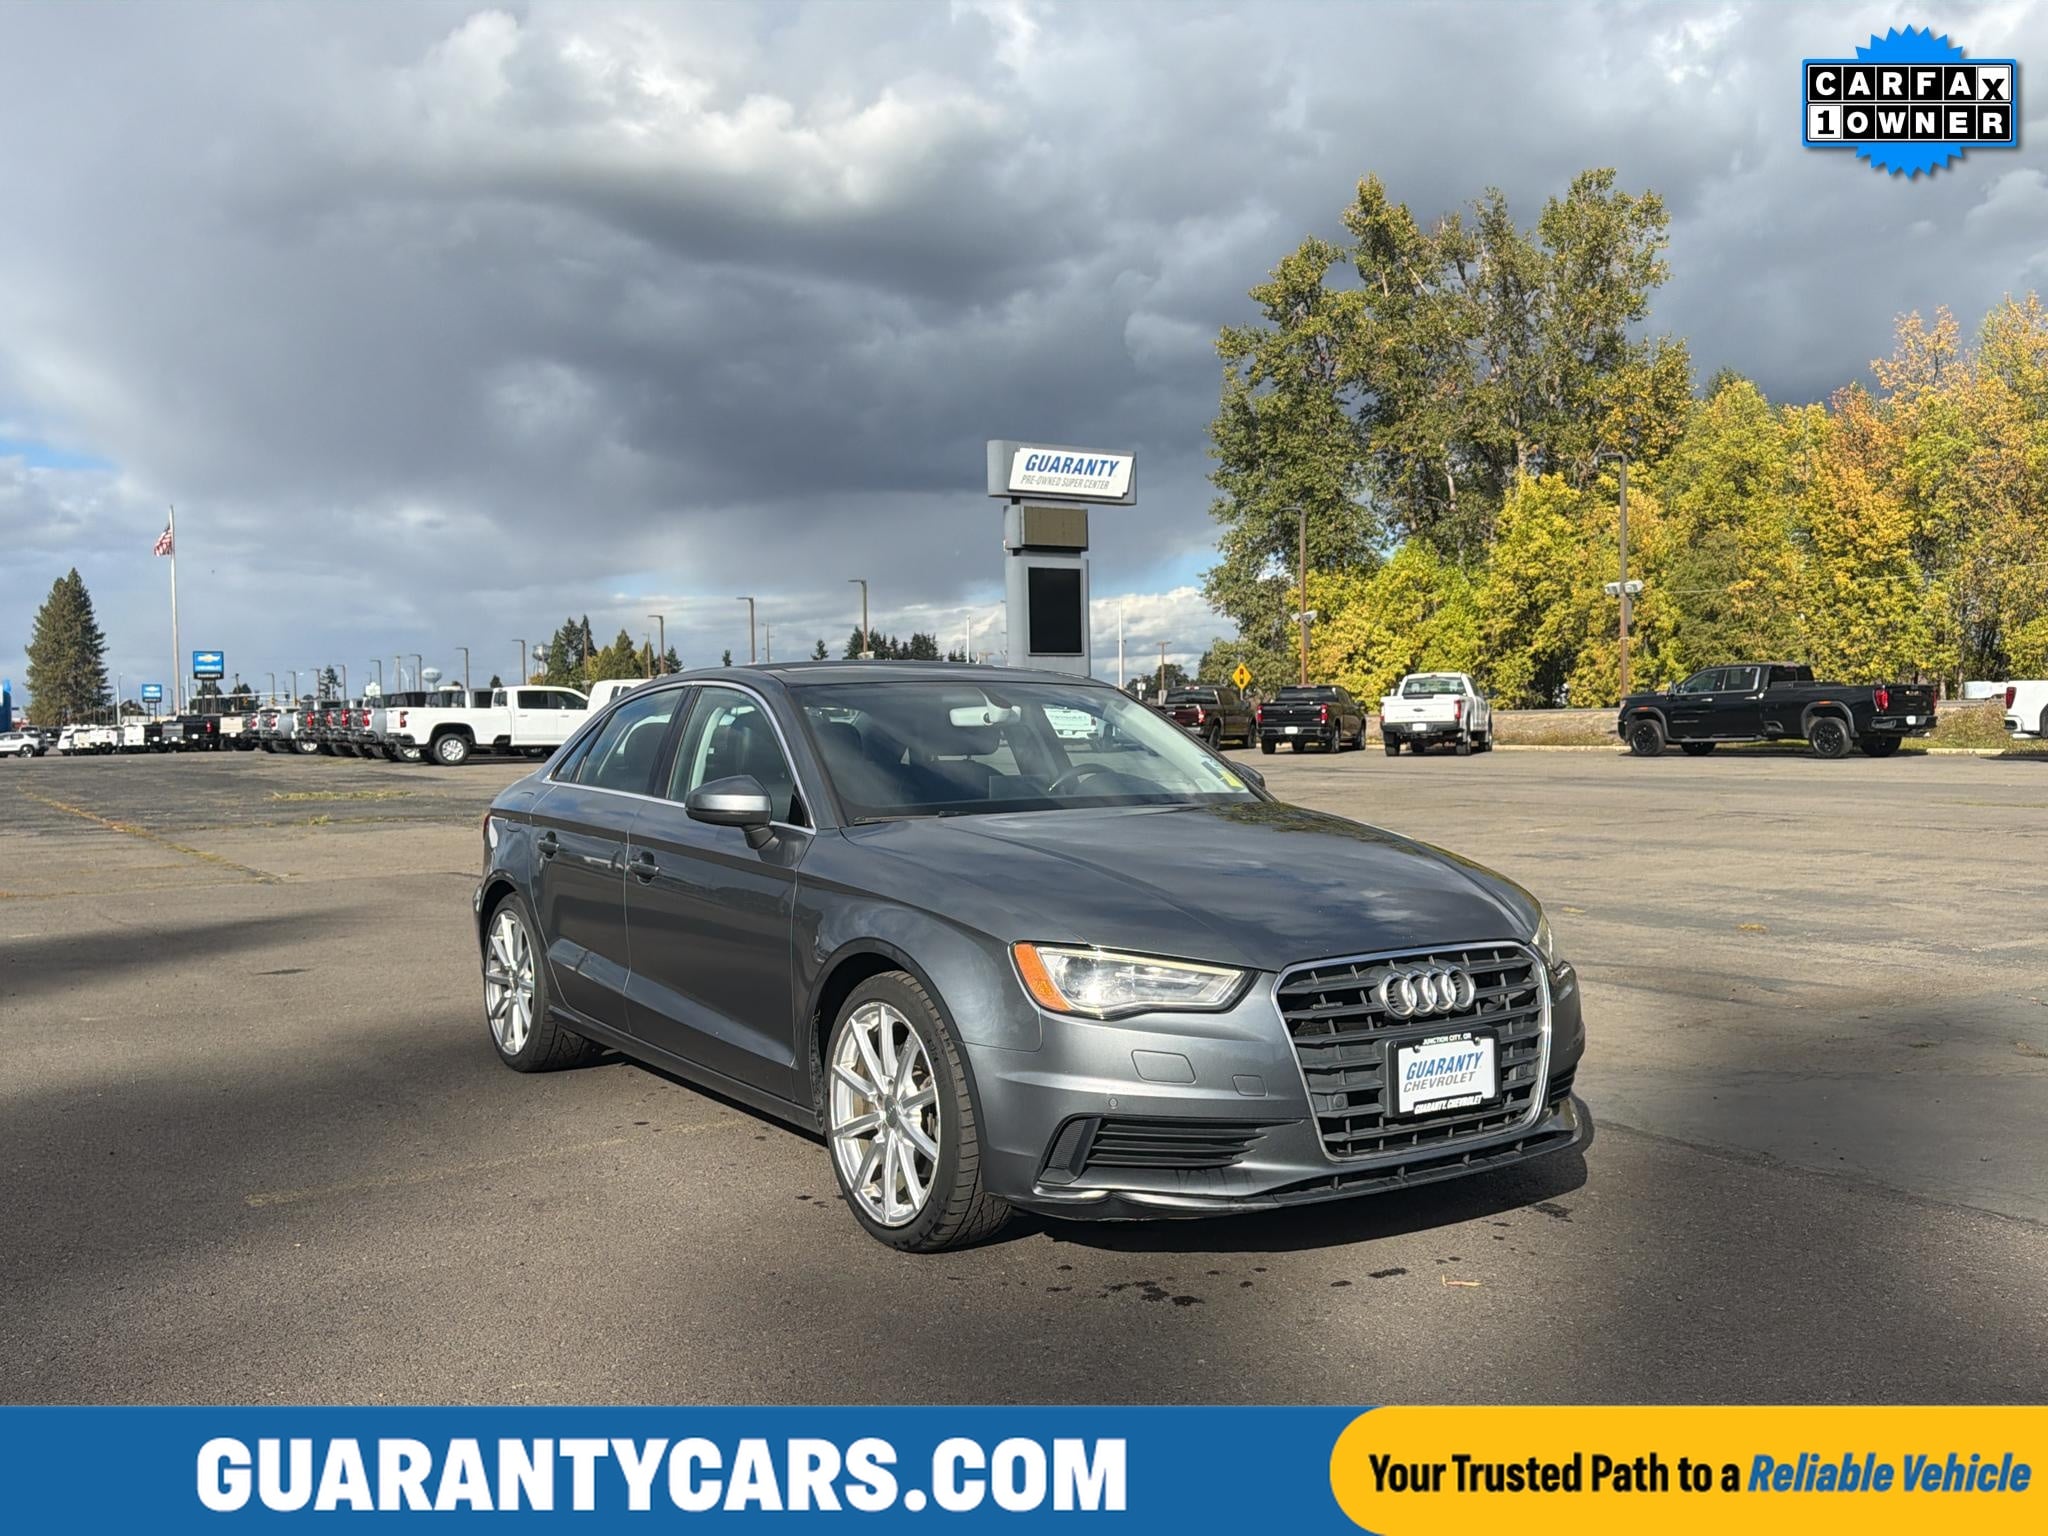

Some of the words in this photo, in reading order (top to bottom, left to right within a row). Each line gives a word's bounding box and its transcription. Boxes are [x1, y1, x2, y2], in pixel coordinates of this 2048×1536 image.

[1025, 454, 1120, 477] GUARANTY
[1021, 474, 1061, 487] PRE-OWNED
[1061, 477, 1083, 488] SUPER
[1083, 479, 1110, 490] CENTER
[1407, 1051, 1483, 1080] GUARANTY
[1403, 1071, 1476, 1093] CHEVROLET
